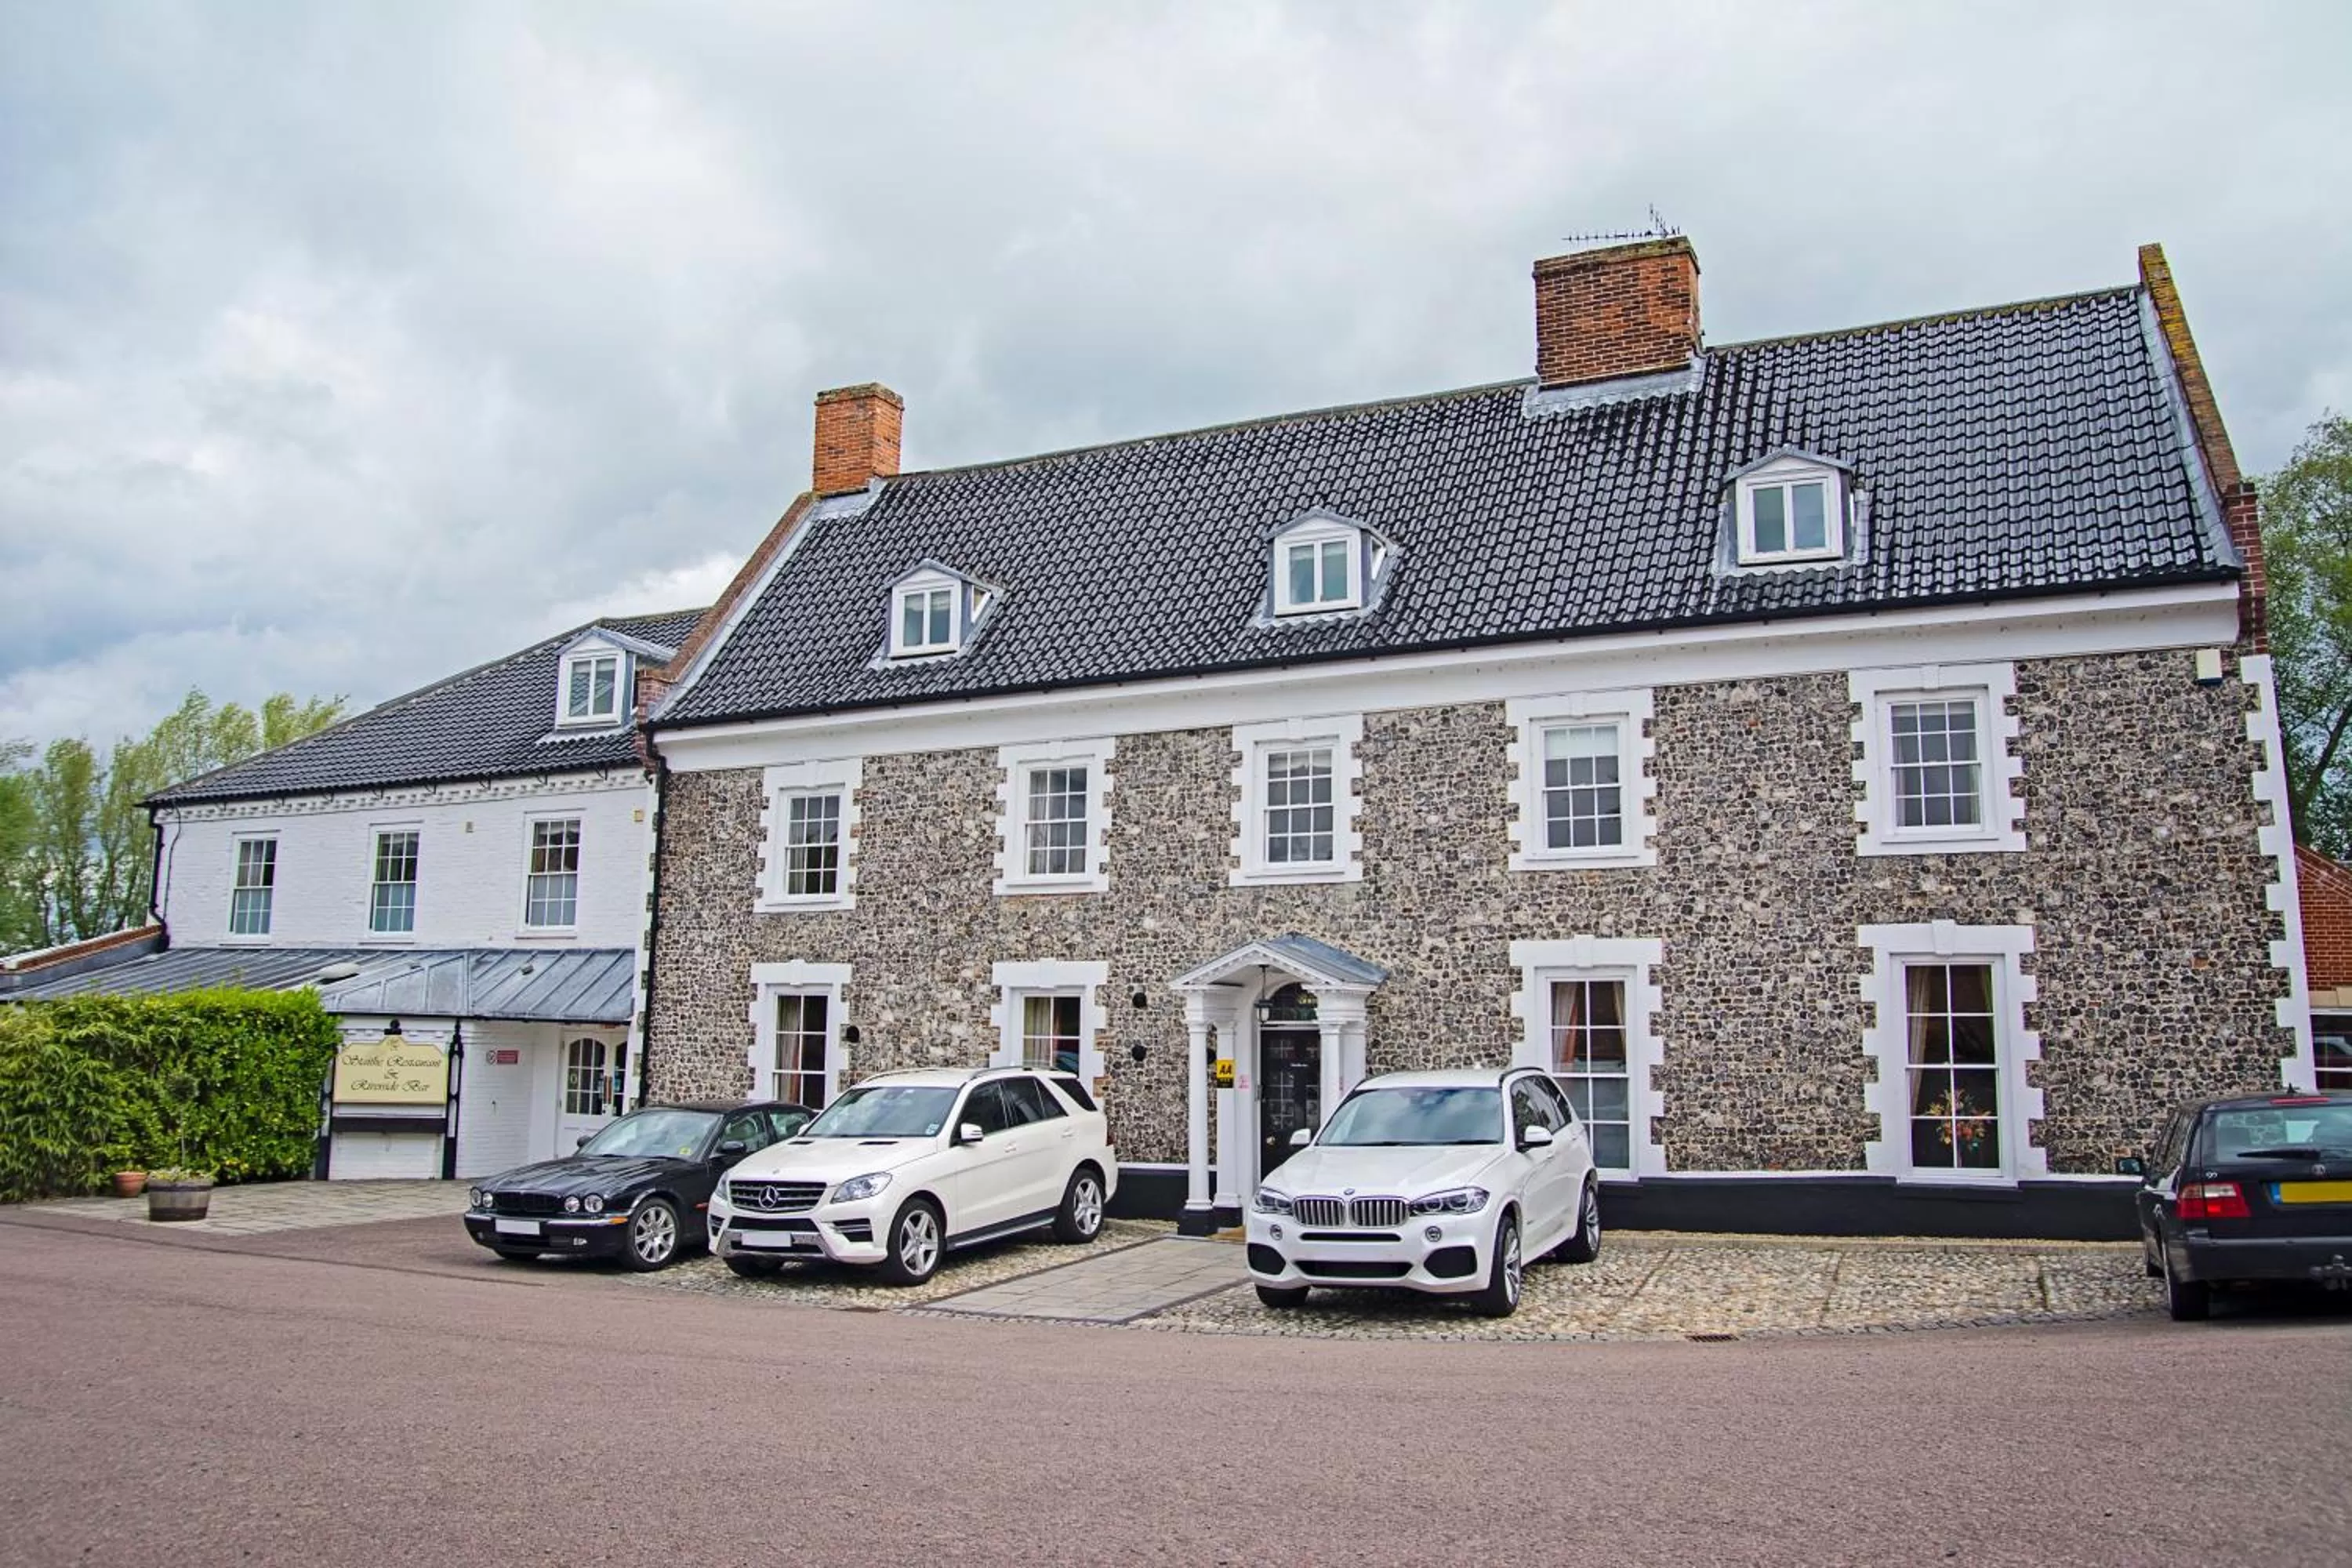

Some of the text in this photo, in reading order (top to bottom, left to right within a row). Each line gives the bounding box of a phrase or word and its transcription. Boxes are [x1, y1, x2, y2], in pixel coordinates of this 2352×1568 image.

[387, 1055, 441, 1066] Restaurant
[1219, 1064, 1232, 1074] AA
[350, 1079, 430, 1092] Riverside Bar
